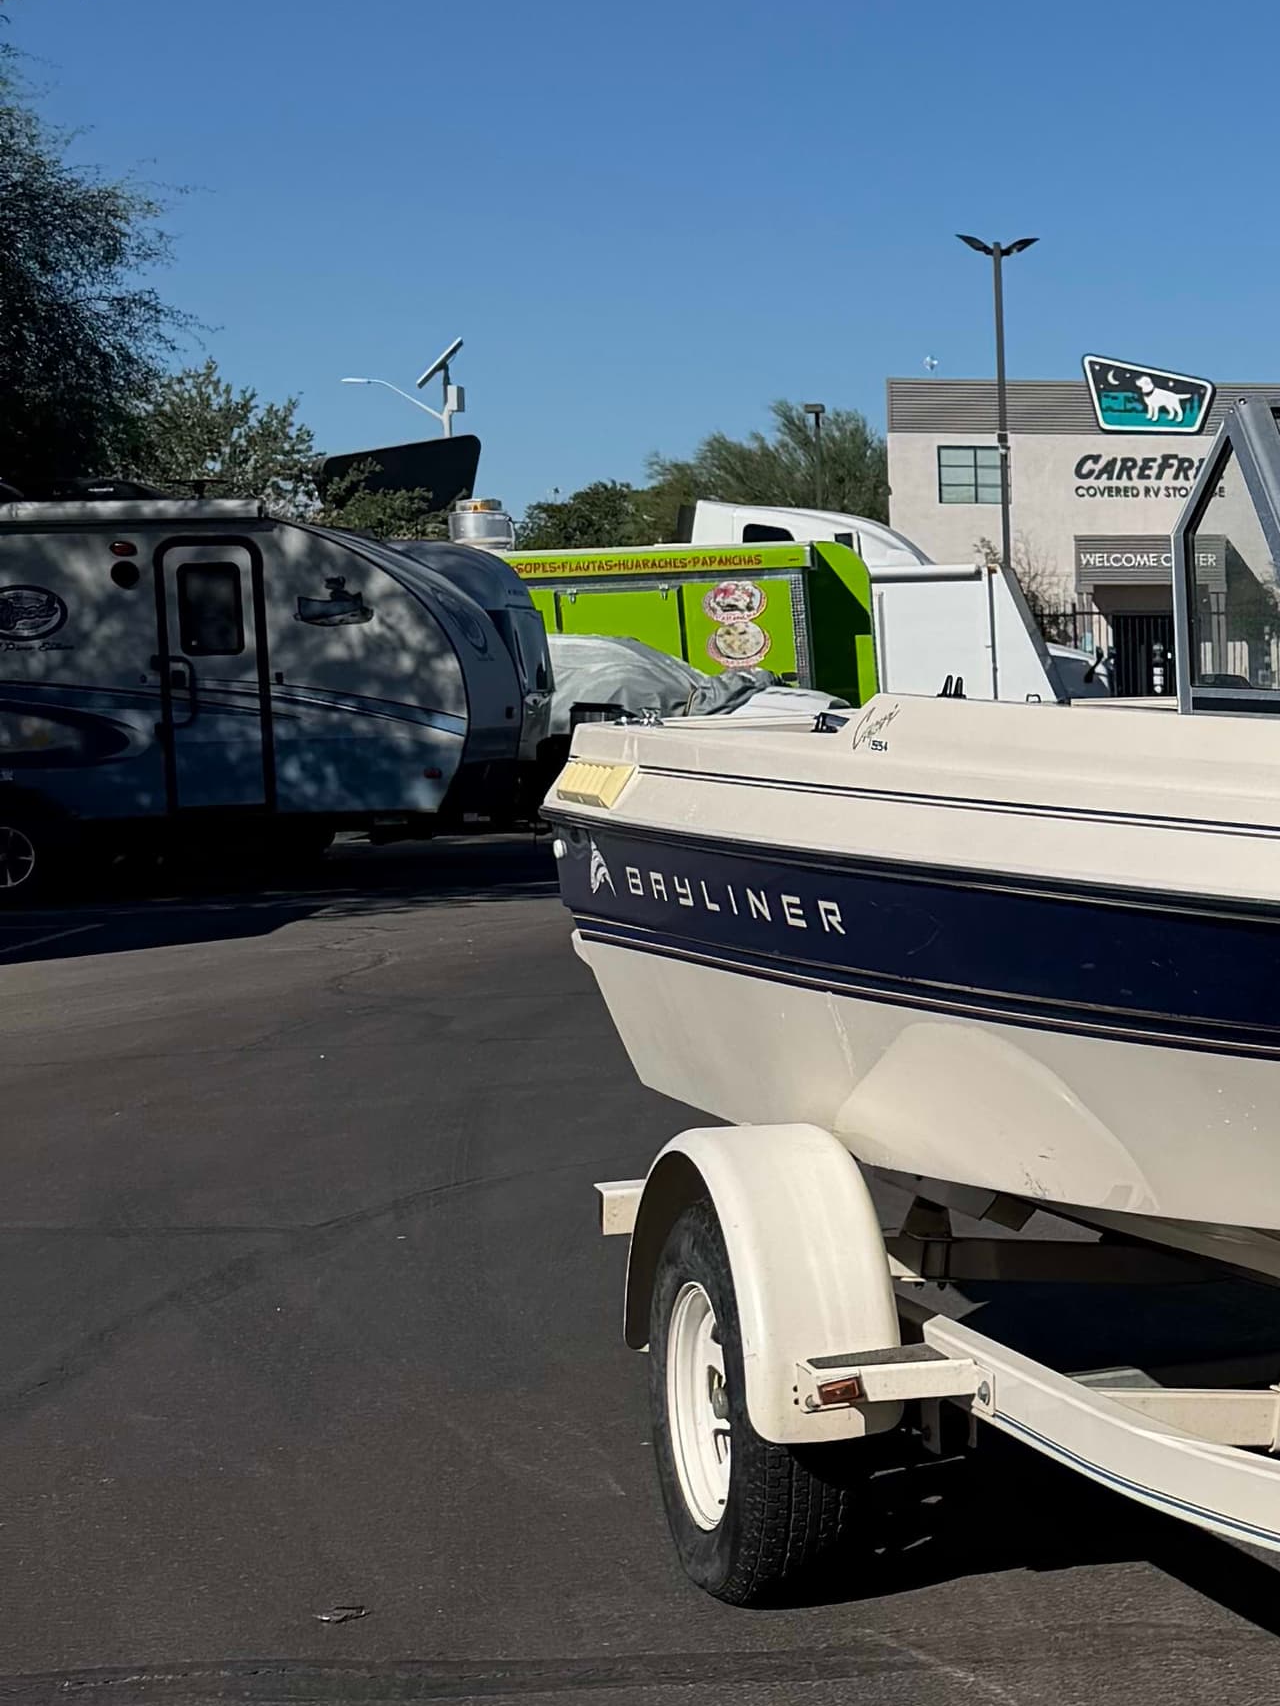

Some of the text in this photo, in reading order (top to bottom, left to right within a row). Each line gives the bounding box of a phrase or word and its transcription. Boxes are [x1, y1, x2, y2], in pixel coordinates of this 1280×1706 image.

[1074, 453, 1224, 481] CAREFR
[1074, 485, 1226, 499] COVERED RV STOE
[560, 559, 613, 572] FLAUTAS
[617, 556, 688, 571] HUARACHES
[1080, 553, 1217, 567] WELCOME CTER
[625, 865, 847, 936] BAYLINER
